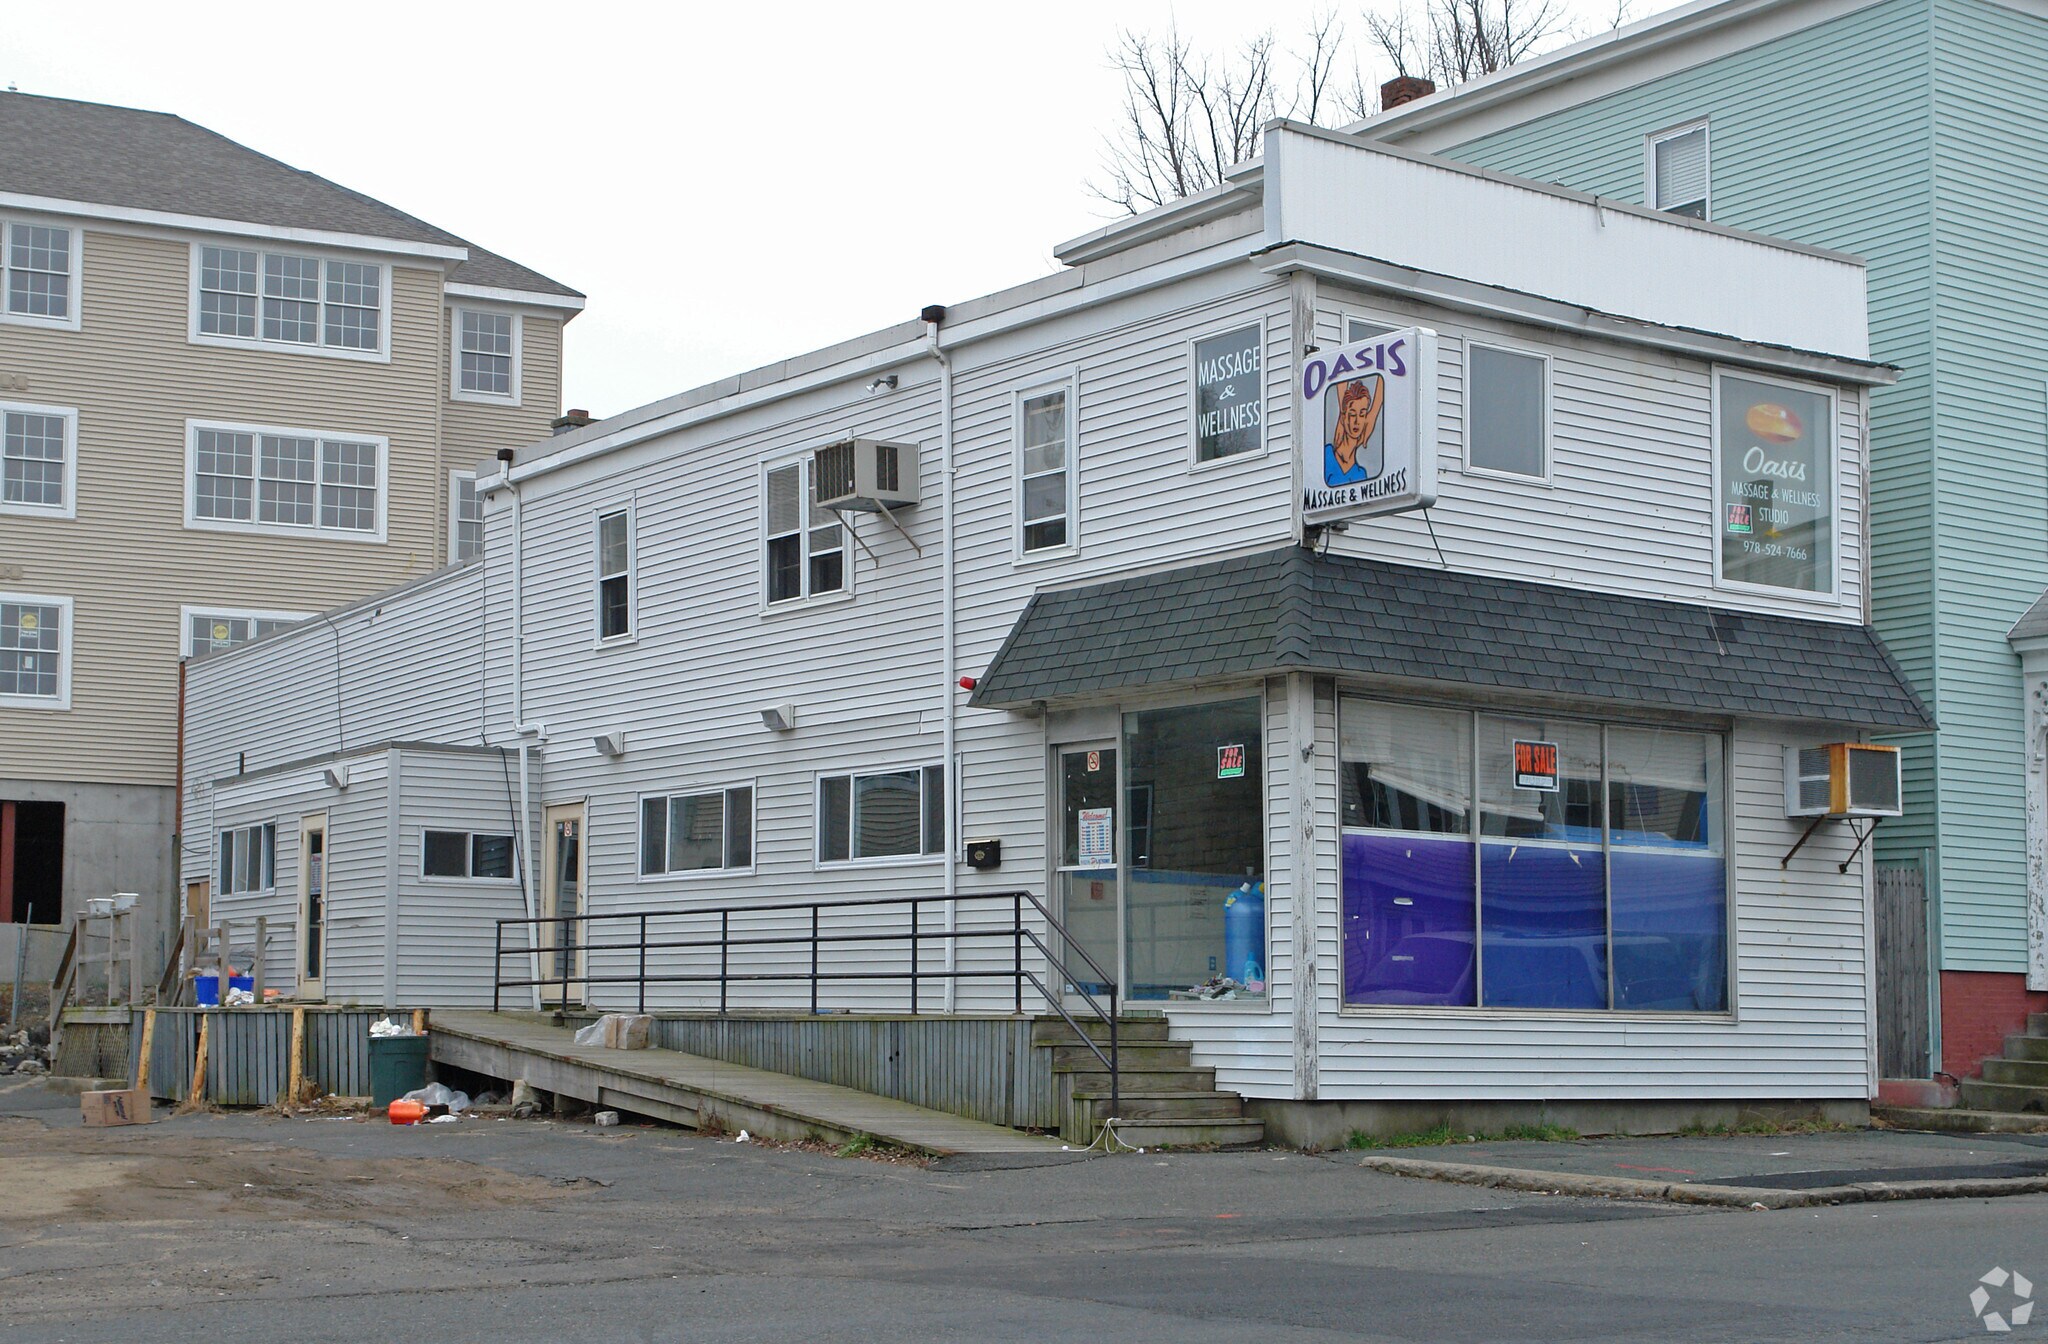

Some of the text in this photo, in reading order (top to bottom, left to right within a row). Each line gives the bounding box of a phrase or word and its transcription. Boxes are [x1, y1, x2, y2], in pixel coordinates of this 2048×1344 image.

[1198, 345, 1260, 387] MASSAGE
[1303, 338, 1407, 400] OASIS
[1219, 384, 1236, 400] &
[1198, 400, 1260, 438] WELLNESS
[1743, 446, 1806, 481] Oasis
[1303, 467, 1407, 511] MASSAGE & WELLNESS
[1731, 481, 1821, 508] MASSAGE & WELLNESS
[1729, 514, 1749, 524] SALE
[1759, 507, 1789, 524] STUDIO
[1743, 540, 1807, 560] 978-524-7666
[1220, 755, 1242, 769] SALE
[1225, 748, 1238, 757] FOR
[1516, 743, 1556, 774] FOR SALE
